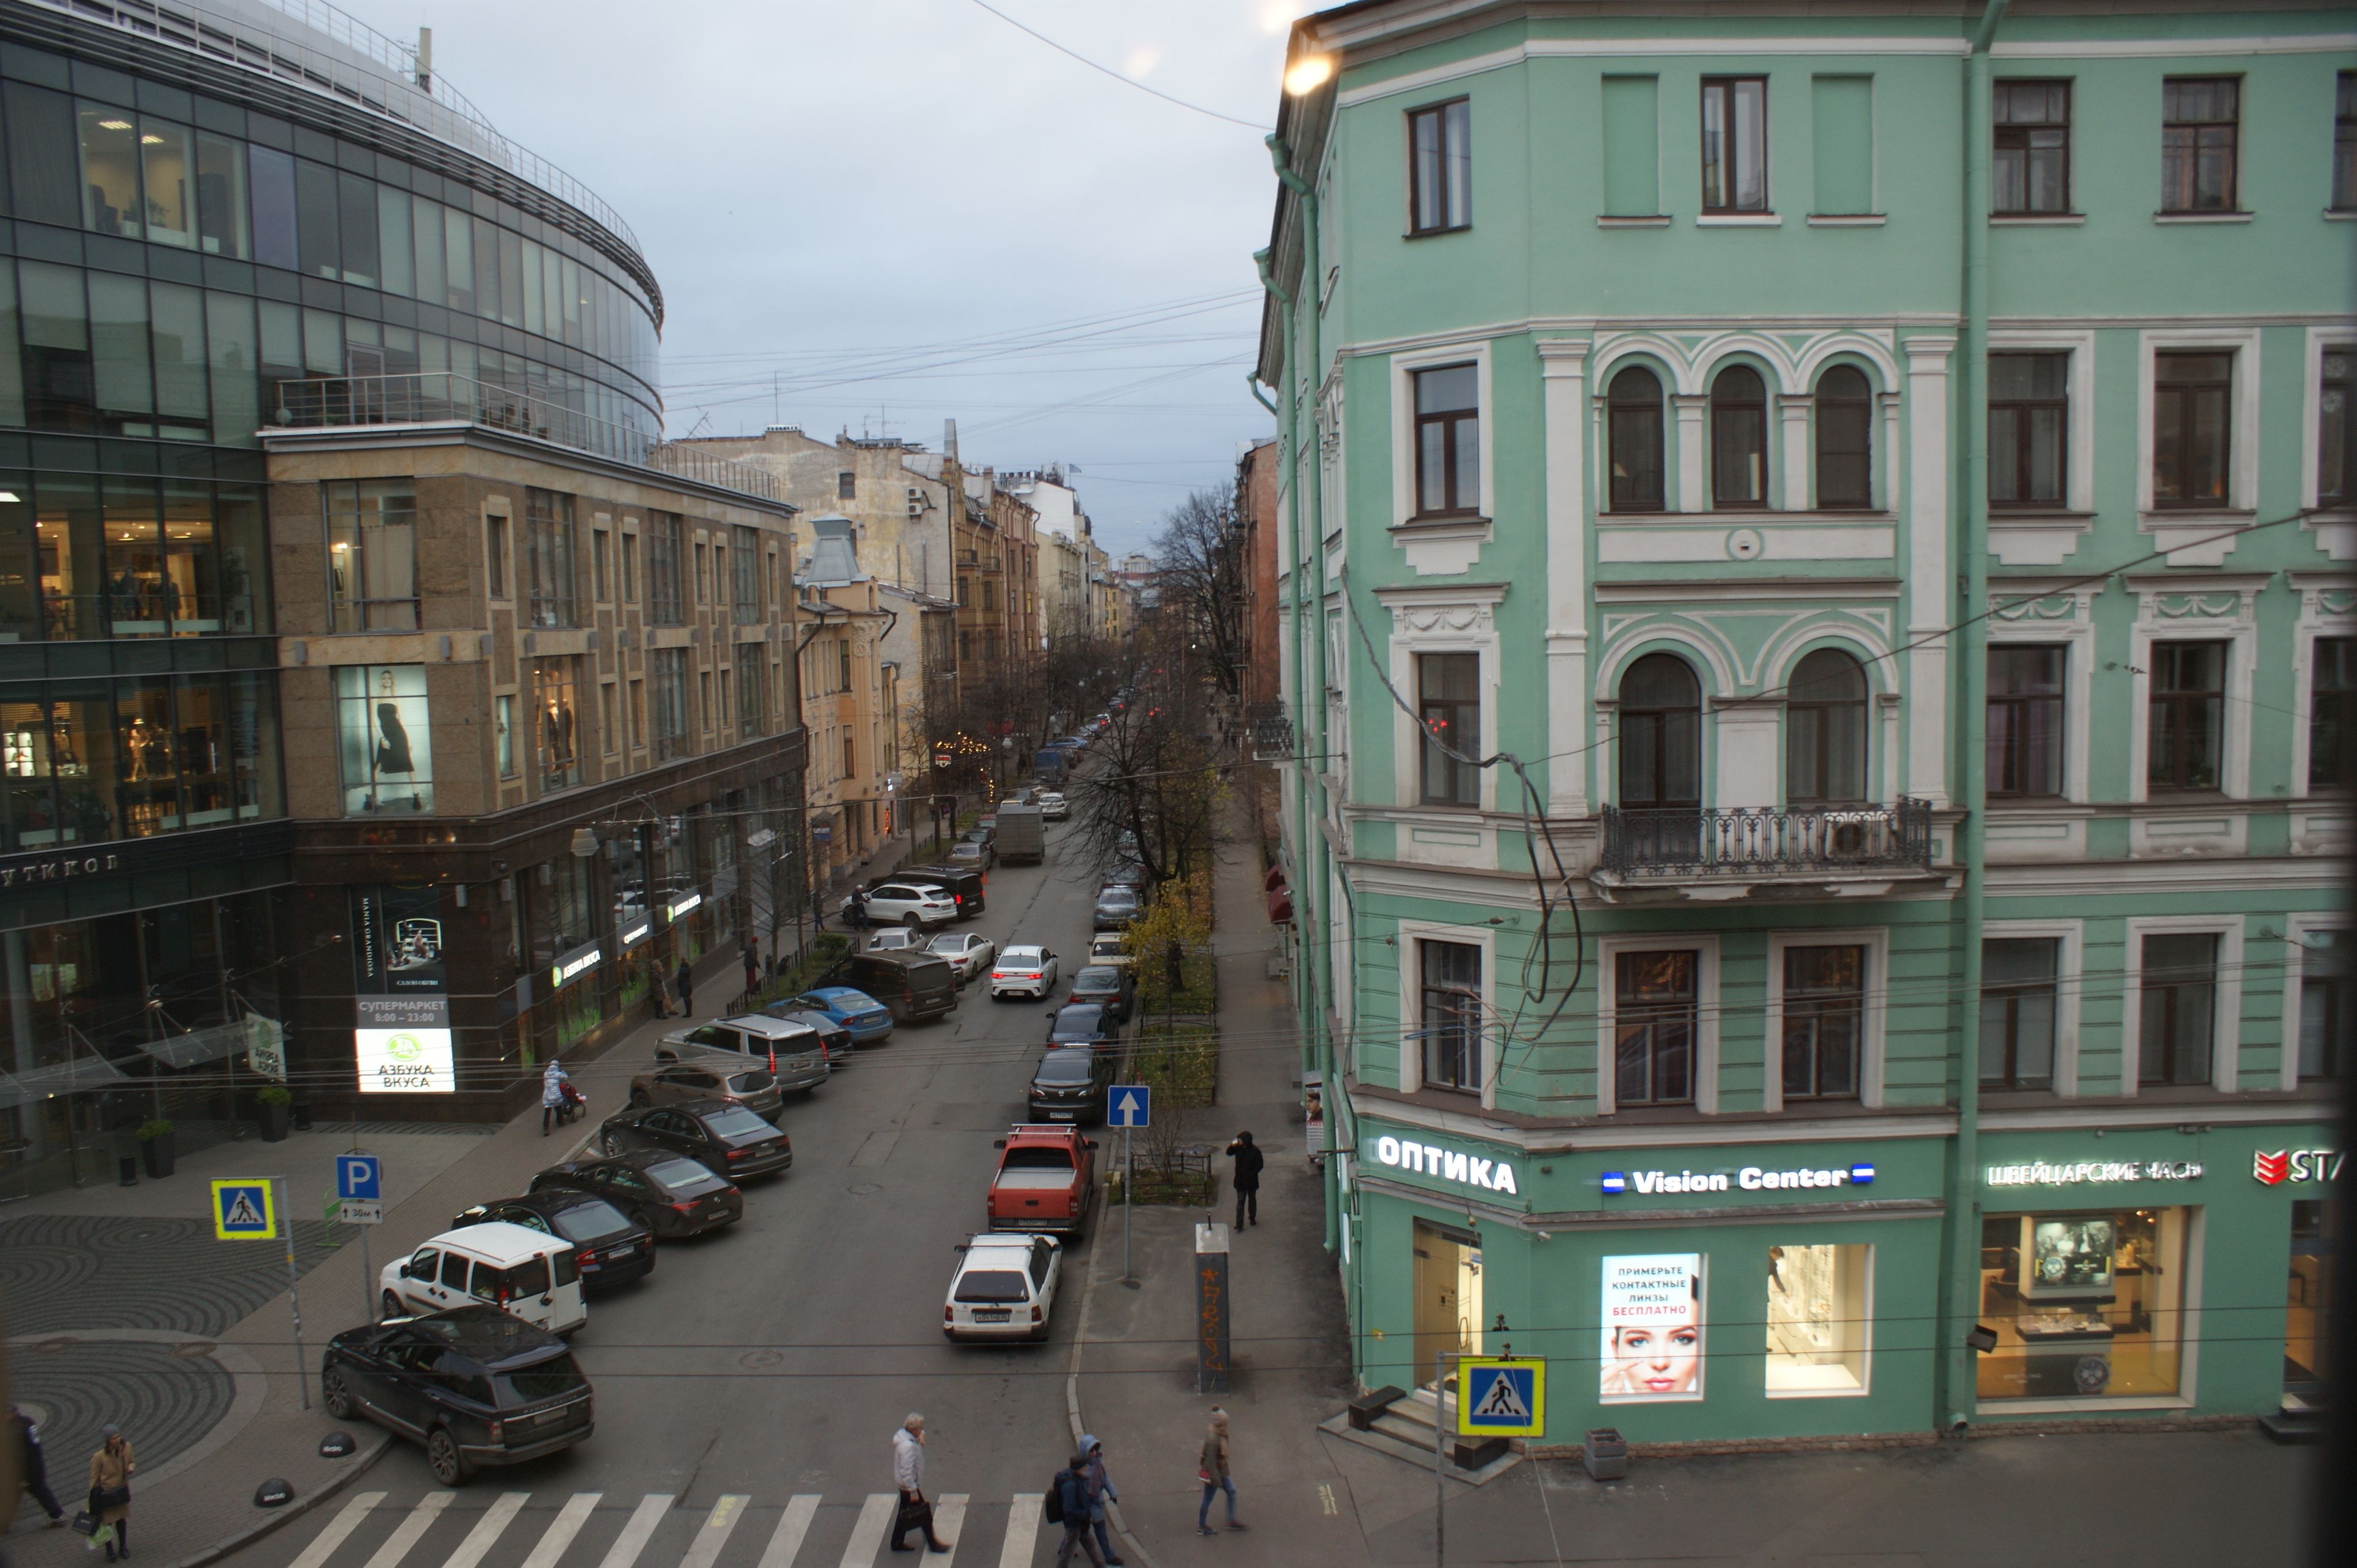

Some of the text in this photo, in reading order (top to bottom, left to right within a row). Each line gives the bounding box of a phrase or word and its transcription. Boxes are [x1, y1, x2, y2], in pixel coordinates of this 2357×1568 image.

[359, 1001, 446, 1012] СУПЕРМАРКЕТ
[375, 1013, 396, 1022] 8:00
[408, 1013, 434, 1022] 23:00
[379, 1065, 435, 1075] АЗБУКА
[384, 1077, 430, 1087] ВКУСА
[1379, 1136, 1517, 1194] ОПТИКА
[348, 1161, 371, 1194] P
[1987, 1161, 2202, 1186] ШВЕЙЦАРСКИЕ ЧАСЫ
[1633, 1167, 1848, 1193] Vision Center
[1619, 1267, 1682, 1275] ПРИМЕРЬТЕ
[1612, 1280, 1686, 1289] КОНТАКТНЫЕ
[1613, 1305, 1686, 1316] БЕСПЛАТНО
